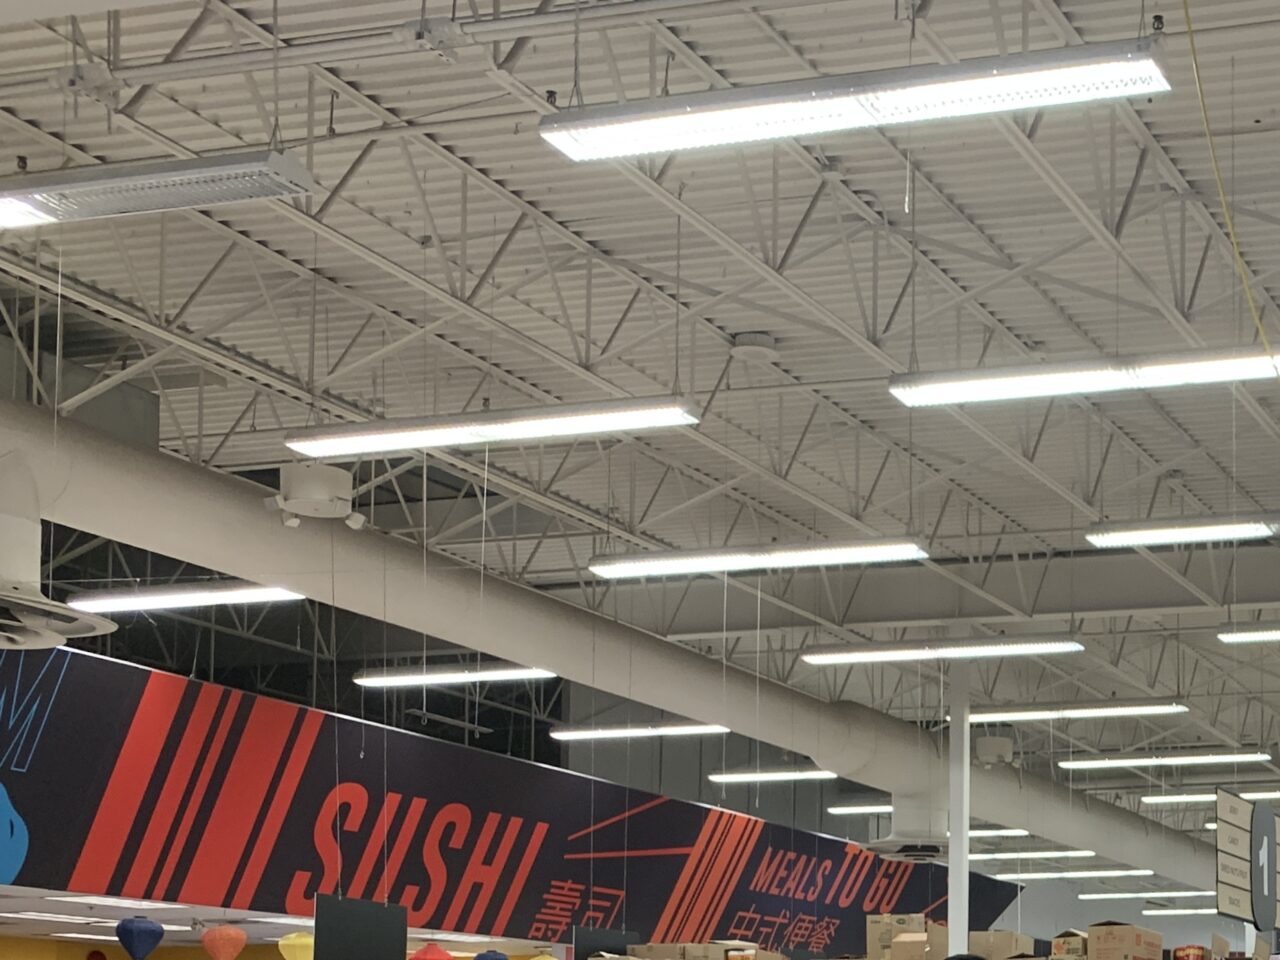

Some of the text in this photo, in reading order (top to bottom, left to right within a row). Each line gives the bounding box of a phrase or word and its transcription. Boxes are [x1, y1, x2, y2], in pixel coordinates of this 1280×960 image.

[286, 782, 549, 936] SUSHI
[750, 843, 913, 914] MEALS TO GO
[1258, 835, 1269, 896] 1
[529, 880, 626, 942] 壽司
[728, 904, 840, 955] 中式便餐
